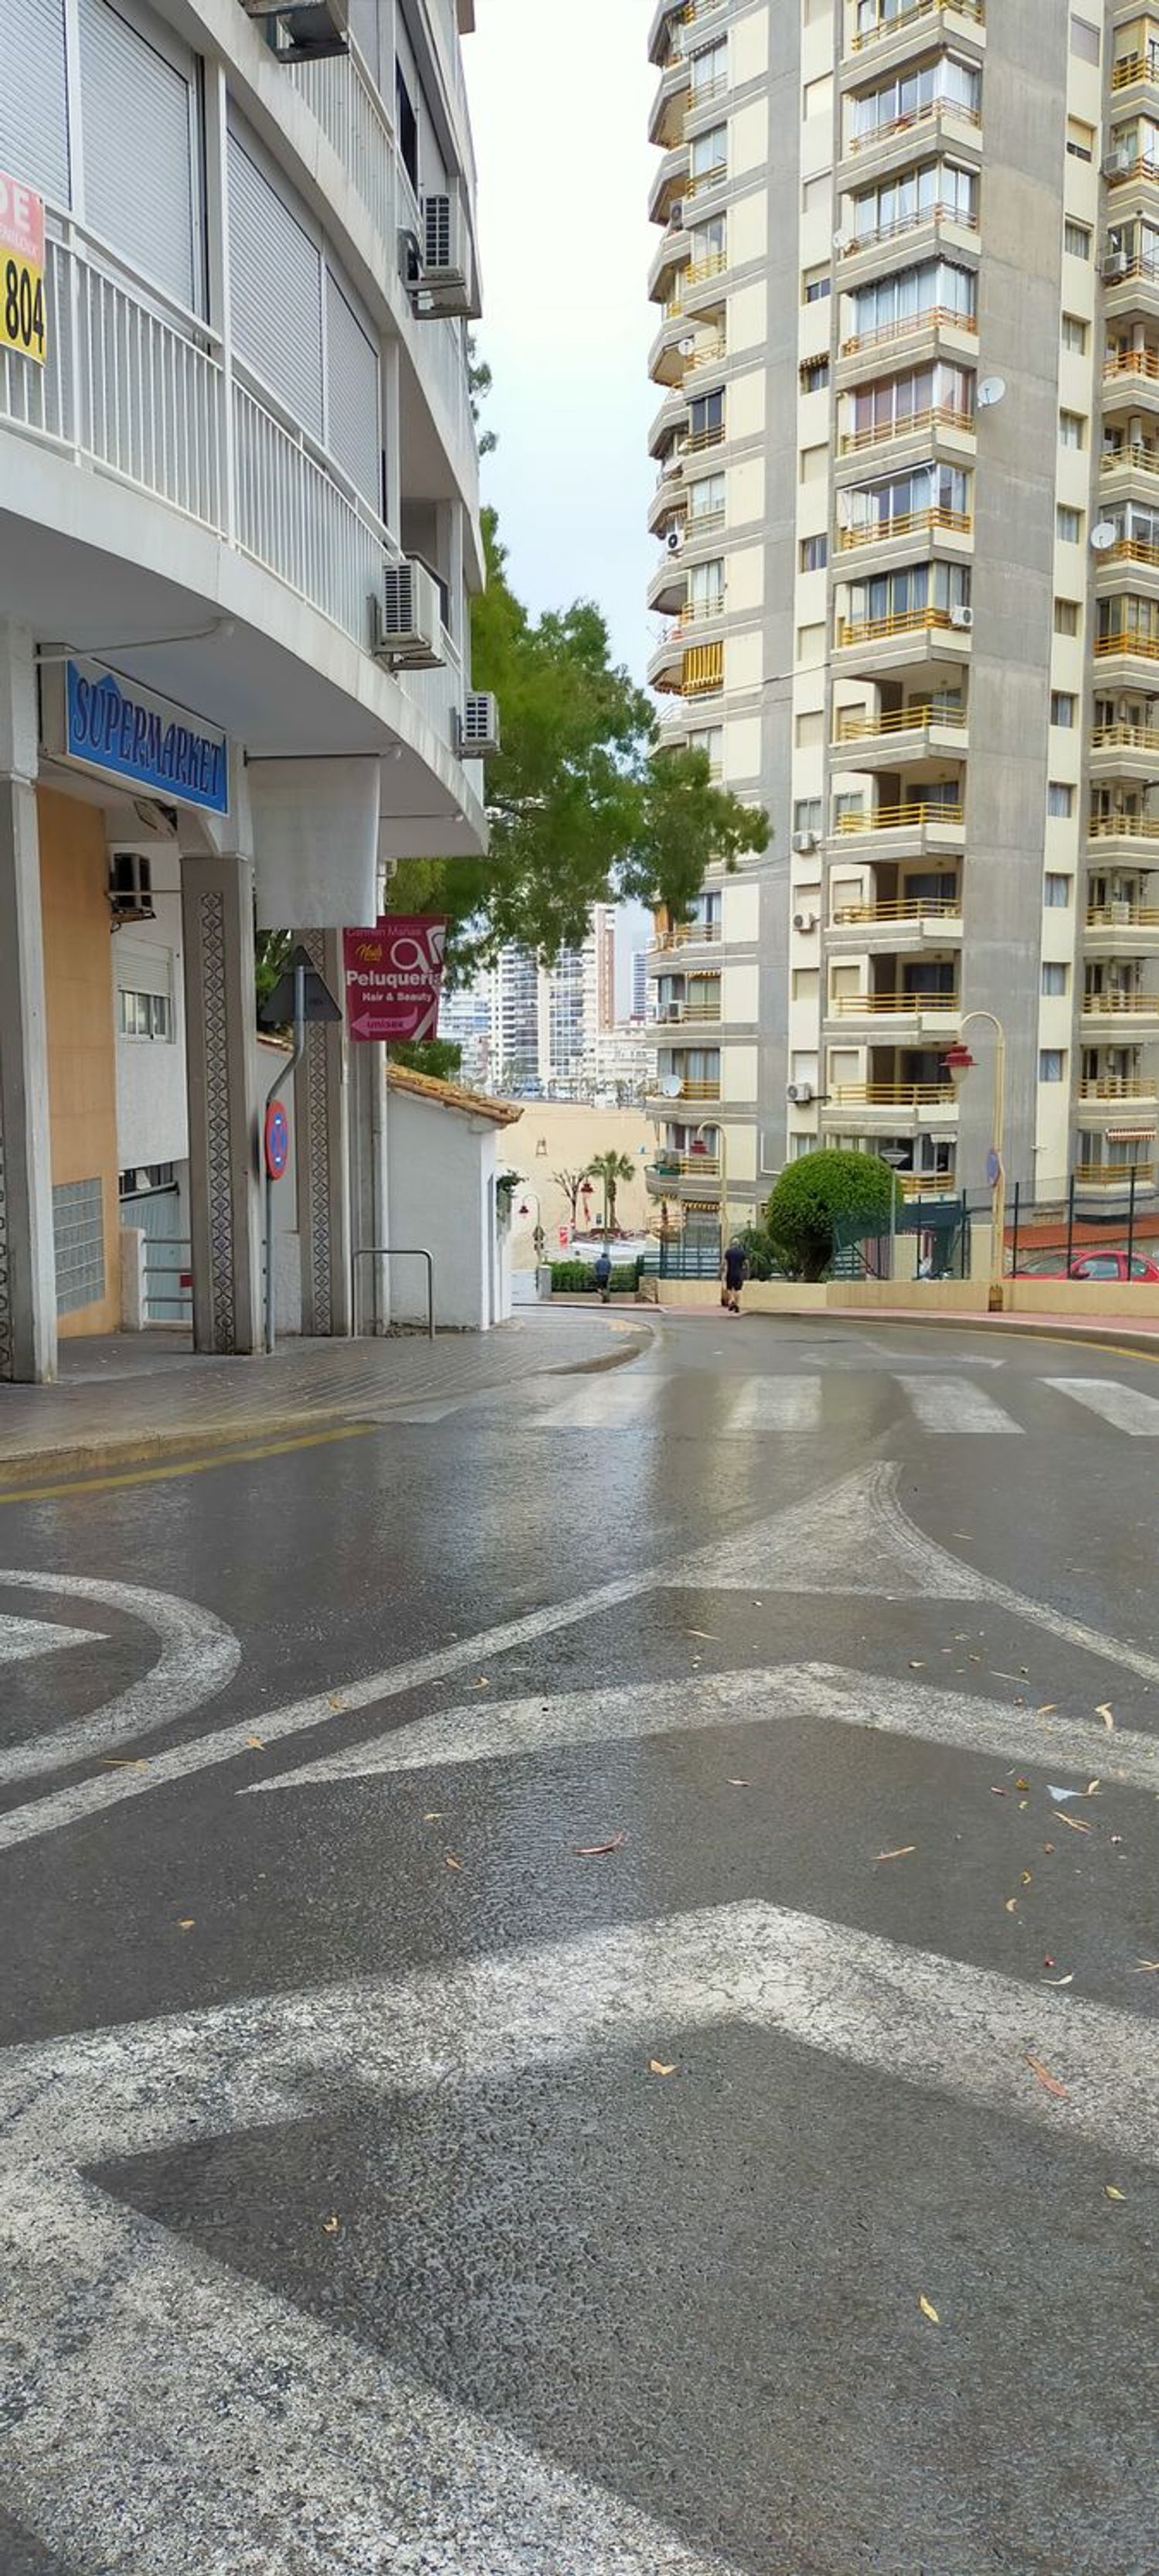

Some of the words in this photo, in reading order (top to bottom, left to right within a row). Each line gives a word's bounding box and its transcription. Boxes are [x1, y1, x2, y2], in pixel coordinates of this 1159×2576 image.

[5, 260, 44, 354] 804
[74, 677, 222, 798] SUPERMARKET
[362, 992, 384, 1002] Hair
[386, 992, 394, 1001] &
[396, 992, 432, 1002] Beauty
[367, 1019, 404, 1029] unisex
